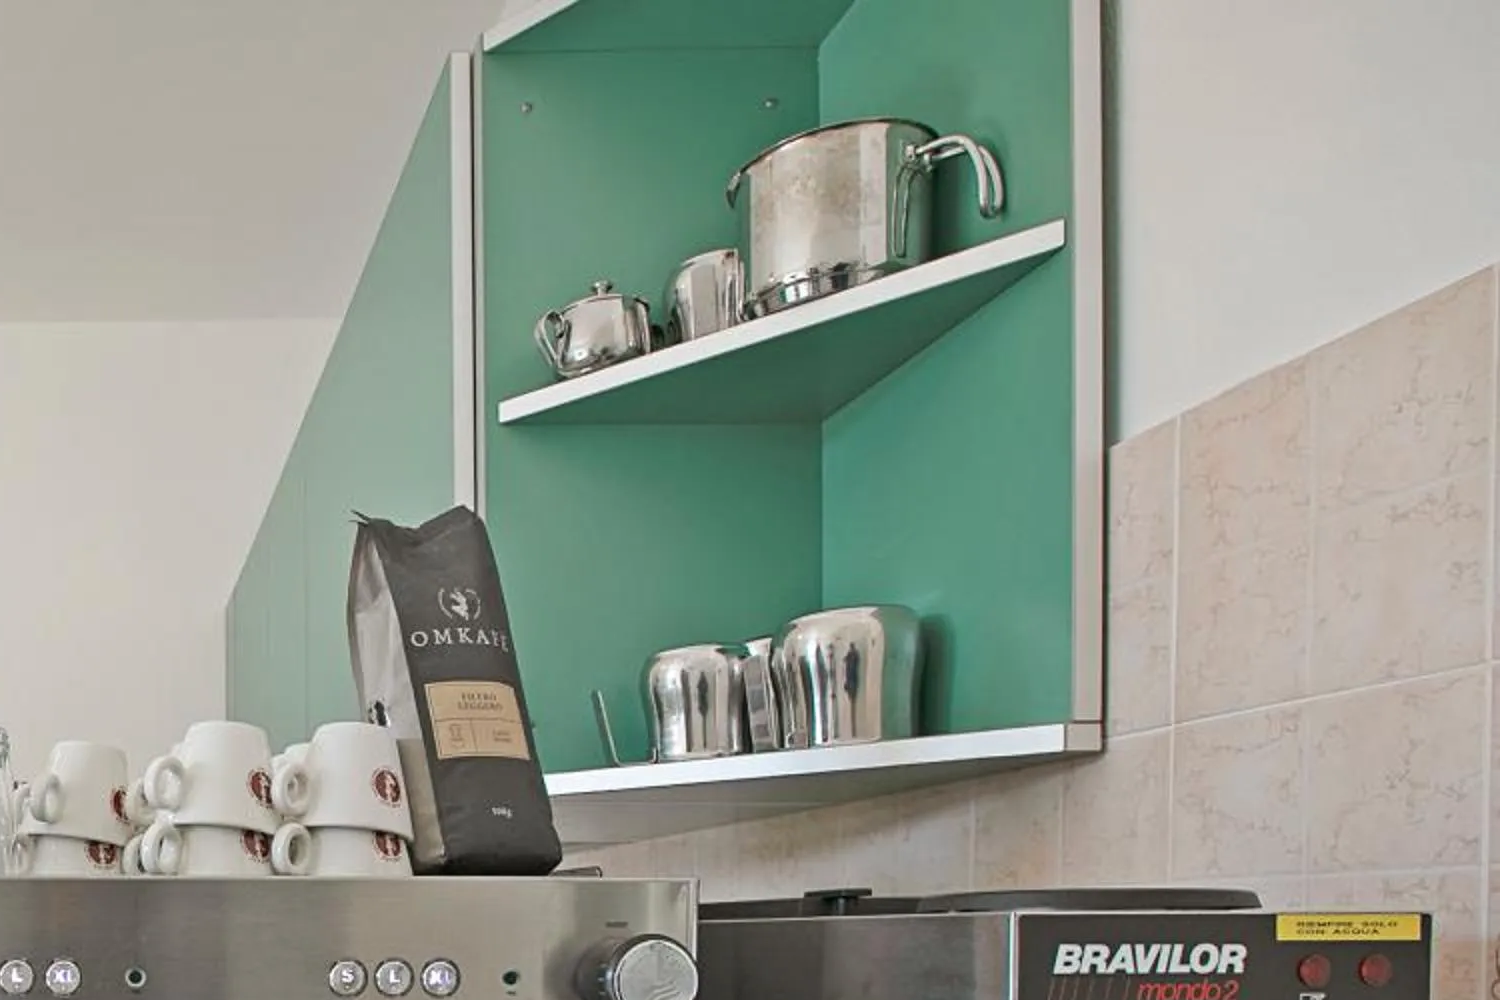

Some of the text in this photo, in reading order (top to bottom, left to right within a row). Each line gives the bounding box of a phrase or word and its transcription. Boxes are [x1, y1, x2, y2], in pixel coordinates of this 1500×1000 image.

[1053, 943, 1247, 975] BRAVILOR
[11, 967, 24, 983] L
[341, 969, 355, 984] S
[389, 969, 401, 983] L
